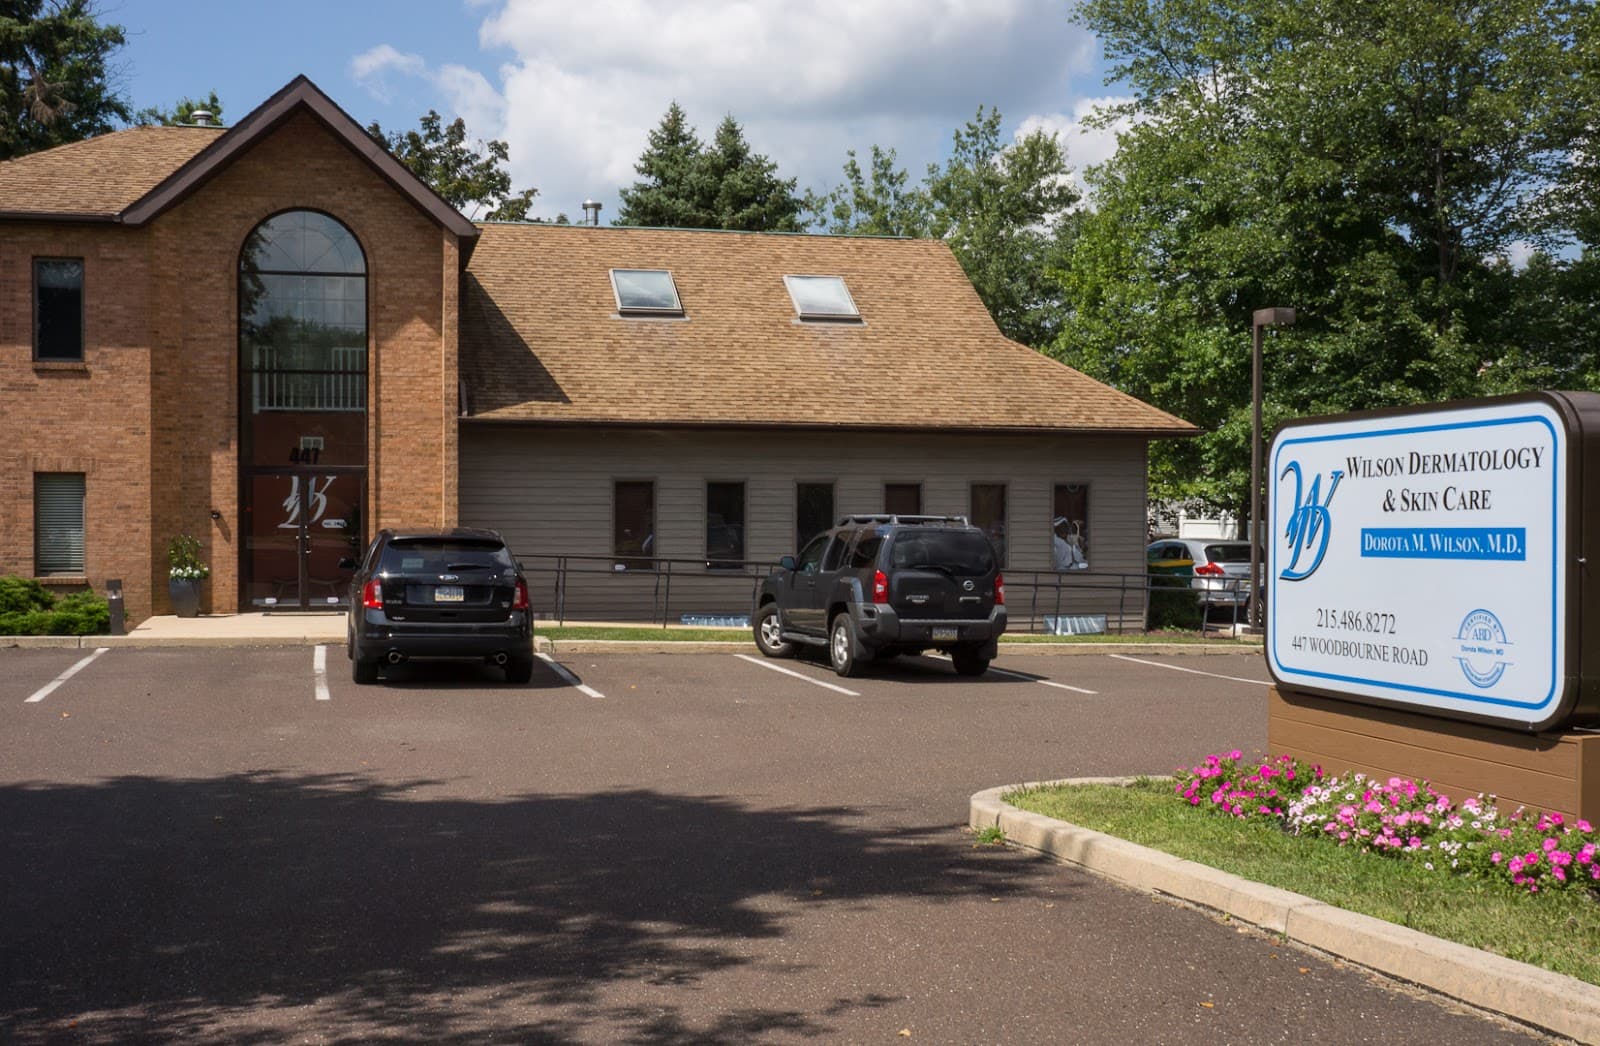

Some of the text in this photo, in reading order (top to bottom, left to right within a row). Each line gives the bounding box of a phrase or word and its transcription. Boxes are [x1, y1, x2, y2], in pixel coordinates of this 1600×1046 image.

[289, 447, 320, 465] 447
[1346, 446, 1544, 479] WILSON DERMATOLOGY
[1382, 486, 1492, 513] & SKIN CARE
[1364, 533, 1522, 555] DOROTA M. WILSON, M.D.
[1317, 607, 1396, 635] 215.486.8272
[1472, 628, 1492, 641] ABD
[1291, 635, 1429, 666] 447 WOODBOURNE ROAD
